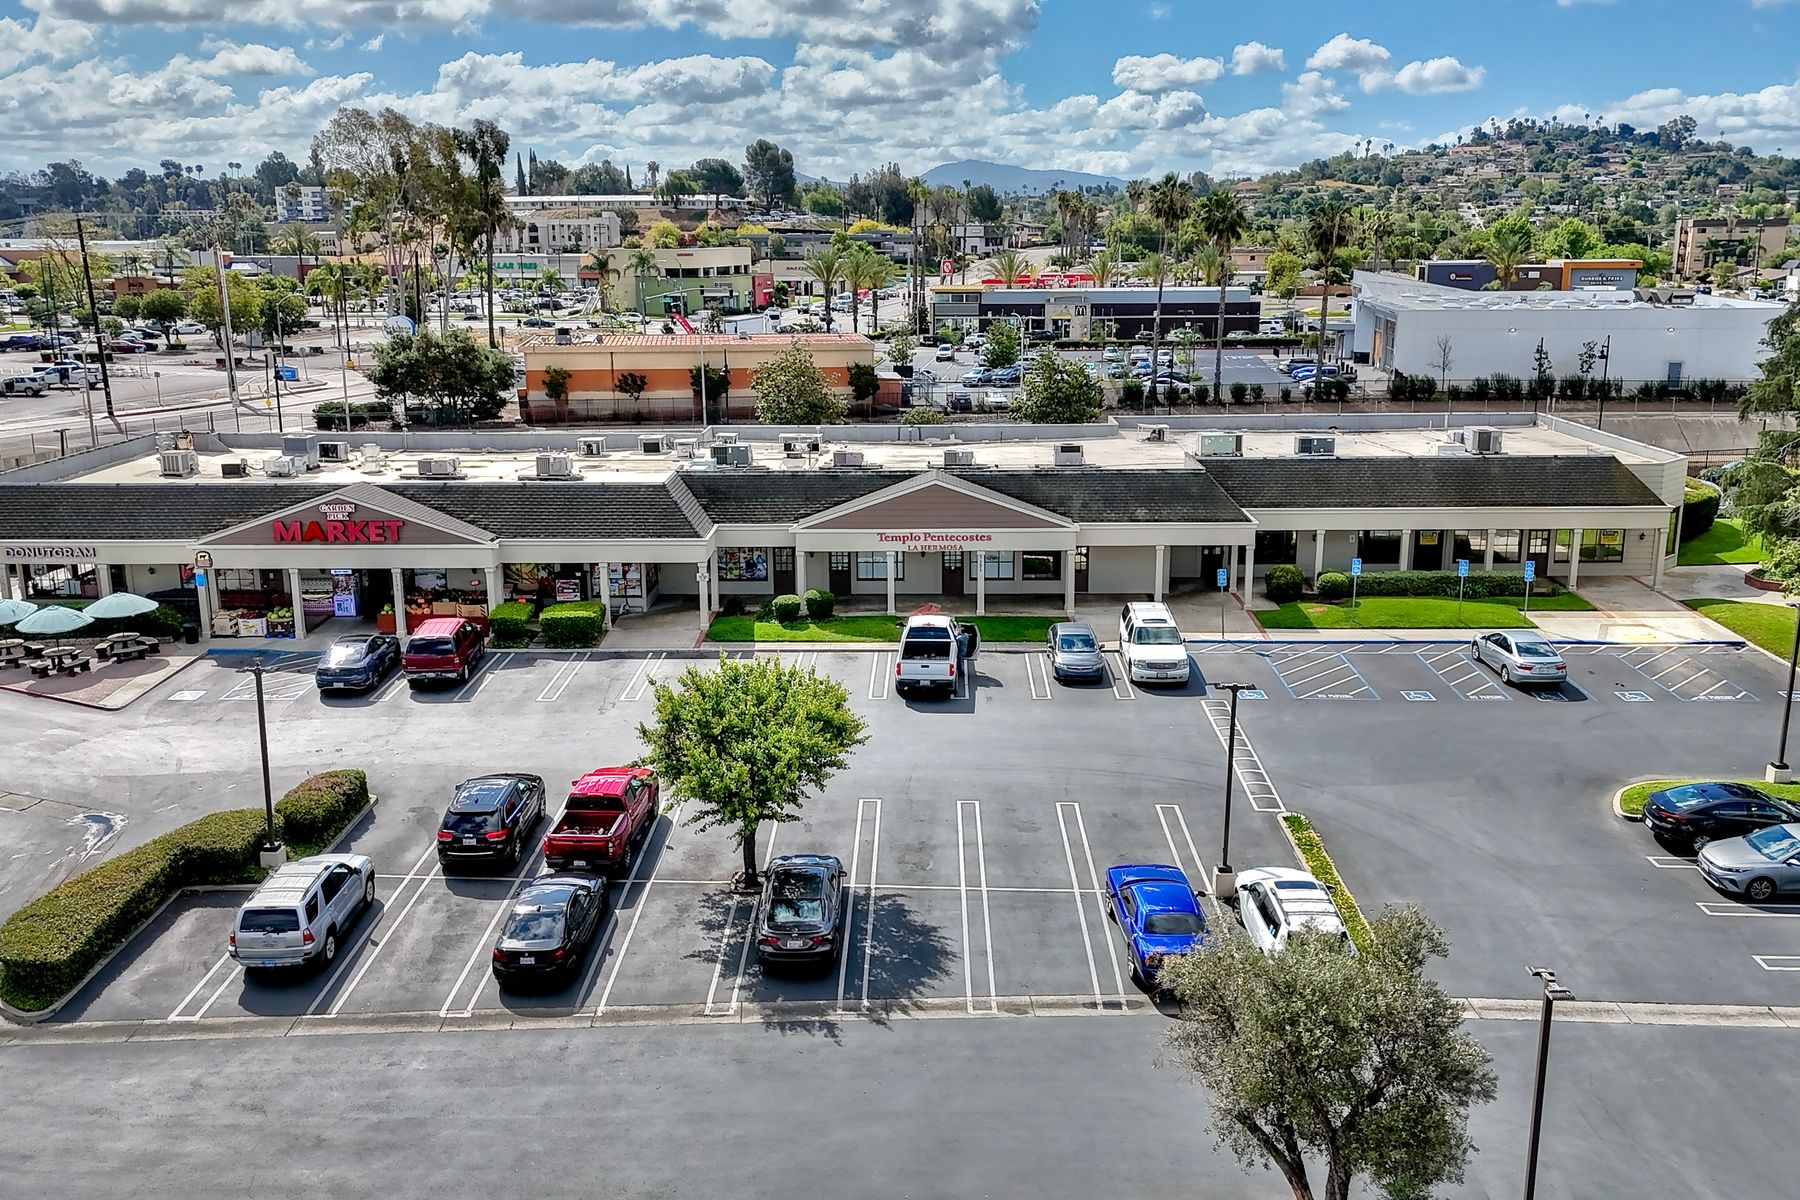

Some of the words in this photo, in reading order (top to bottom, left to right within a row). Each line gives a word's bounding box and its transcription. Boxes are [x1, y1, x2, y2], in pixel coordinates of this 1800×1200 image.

[319, 504, 355, 513] GARDEN
[326, 512, 349, 520] PICK
[273, 519, 404, 543] MARKET
[877, 532, 921, 544] Templo
[923, 532, 992, 542] Pentecostes
[5, 547, 96, 558] DONUTGRAM
